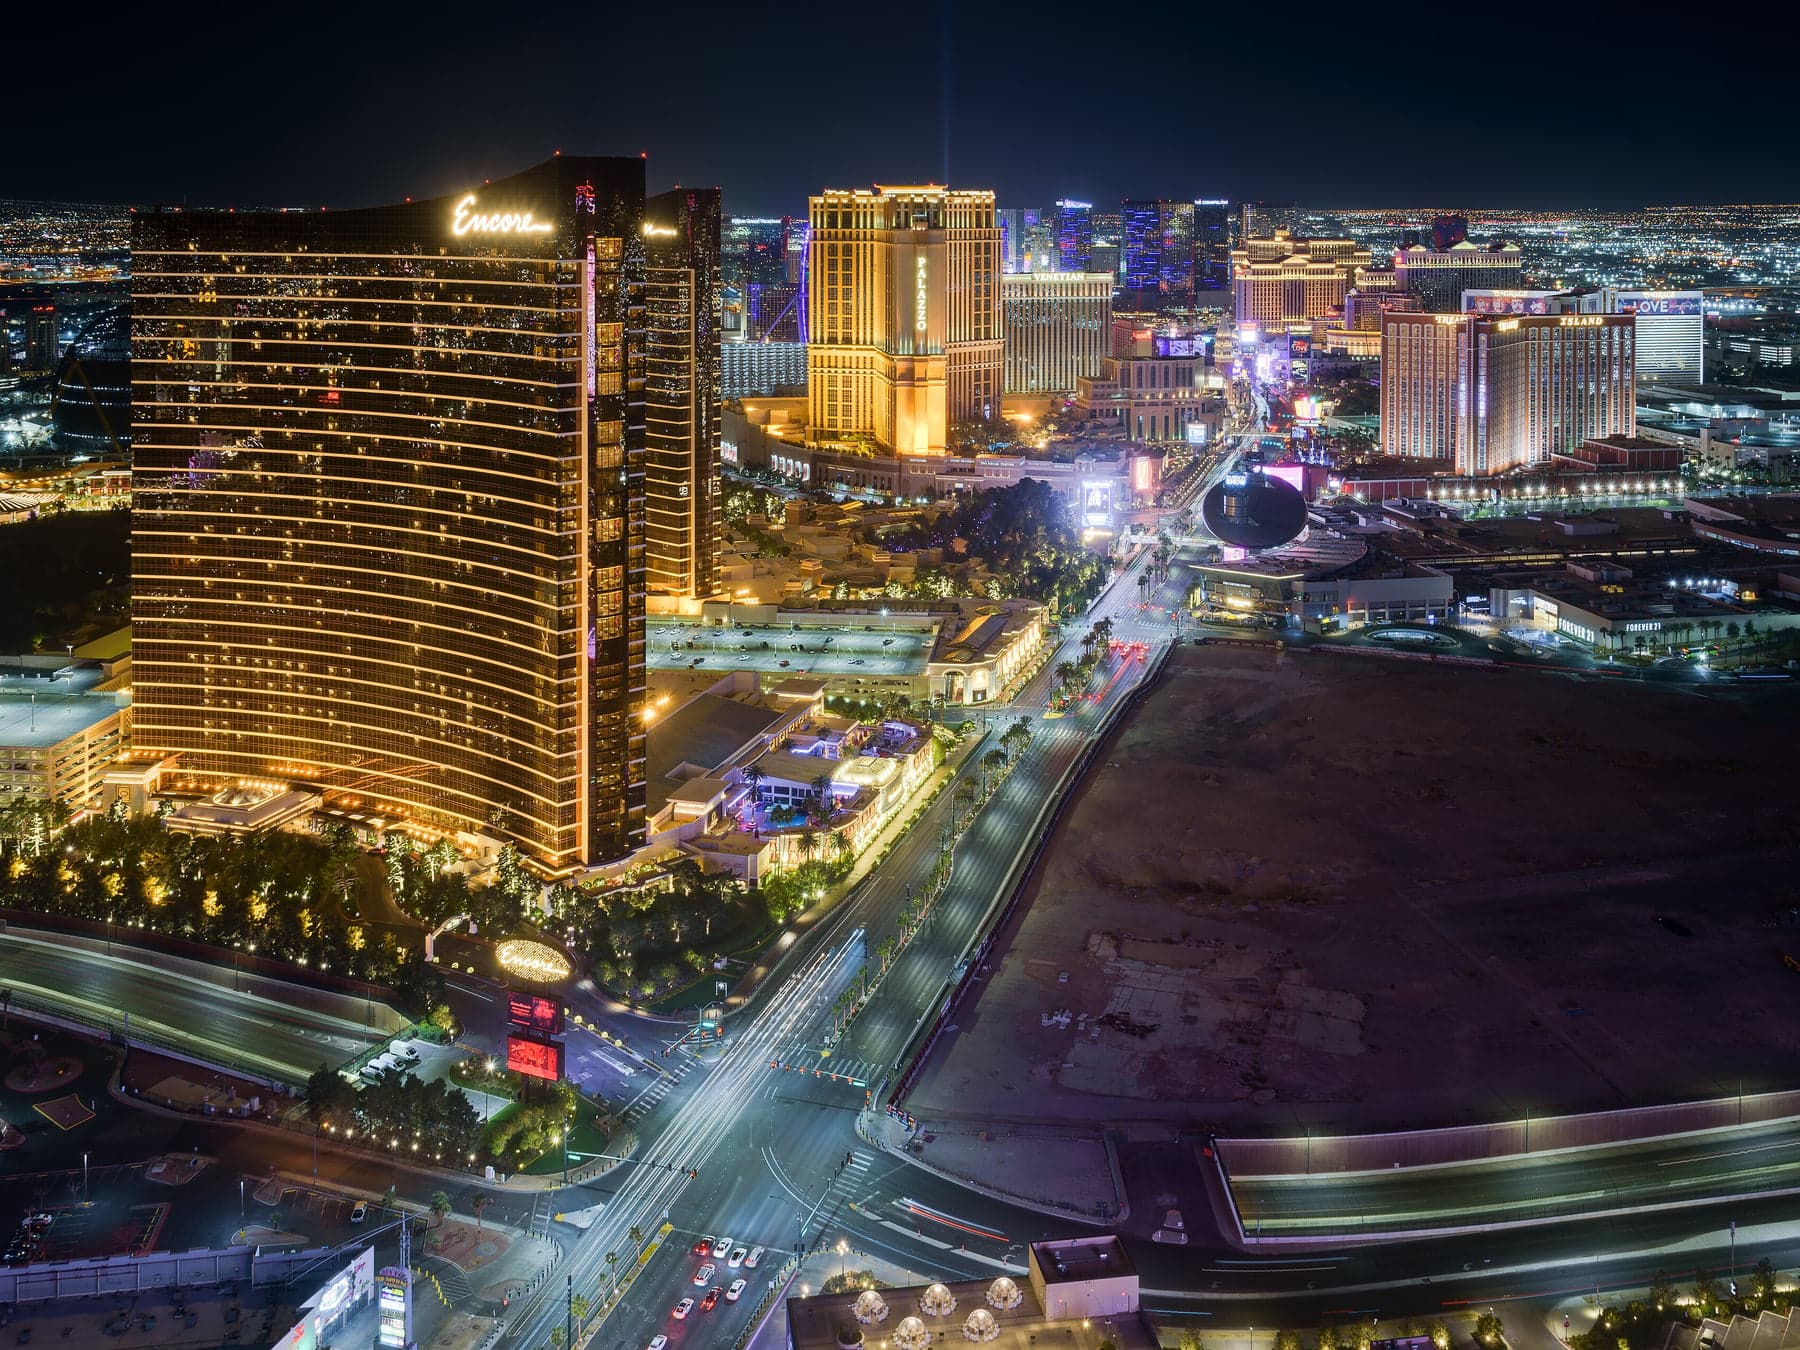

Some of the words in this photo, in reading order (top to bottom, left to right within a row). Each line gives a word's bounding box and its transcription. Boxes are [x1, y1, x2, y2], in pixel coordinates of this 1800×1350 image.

[452, 194, 553, 235] Encore
[1033, 272, 1084, 281] VENETIAN
[917, 257, 927, 330] PALAZZO
[1636, 301, 1668, 313] LOVE
[1560, 317, 1603, 326] ISLAND
[1558, 618, 1586, 639] FOREVER
[1586, 629, 1594, 643] 21
[1626, 623, 1653, 632] FOREVER
[1653, 622, 1661, 630] 21
[500, 945, 569, 975] Encore
